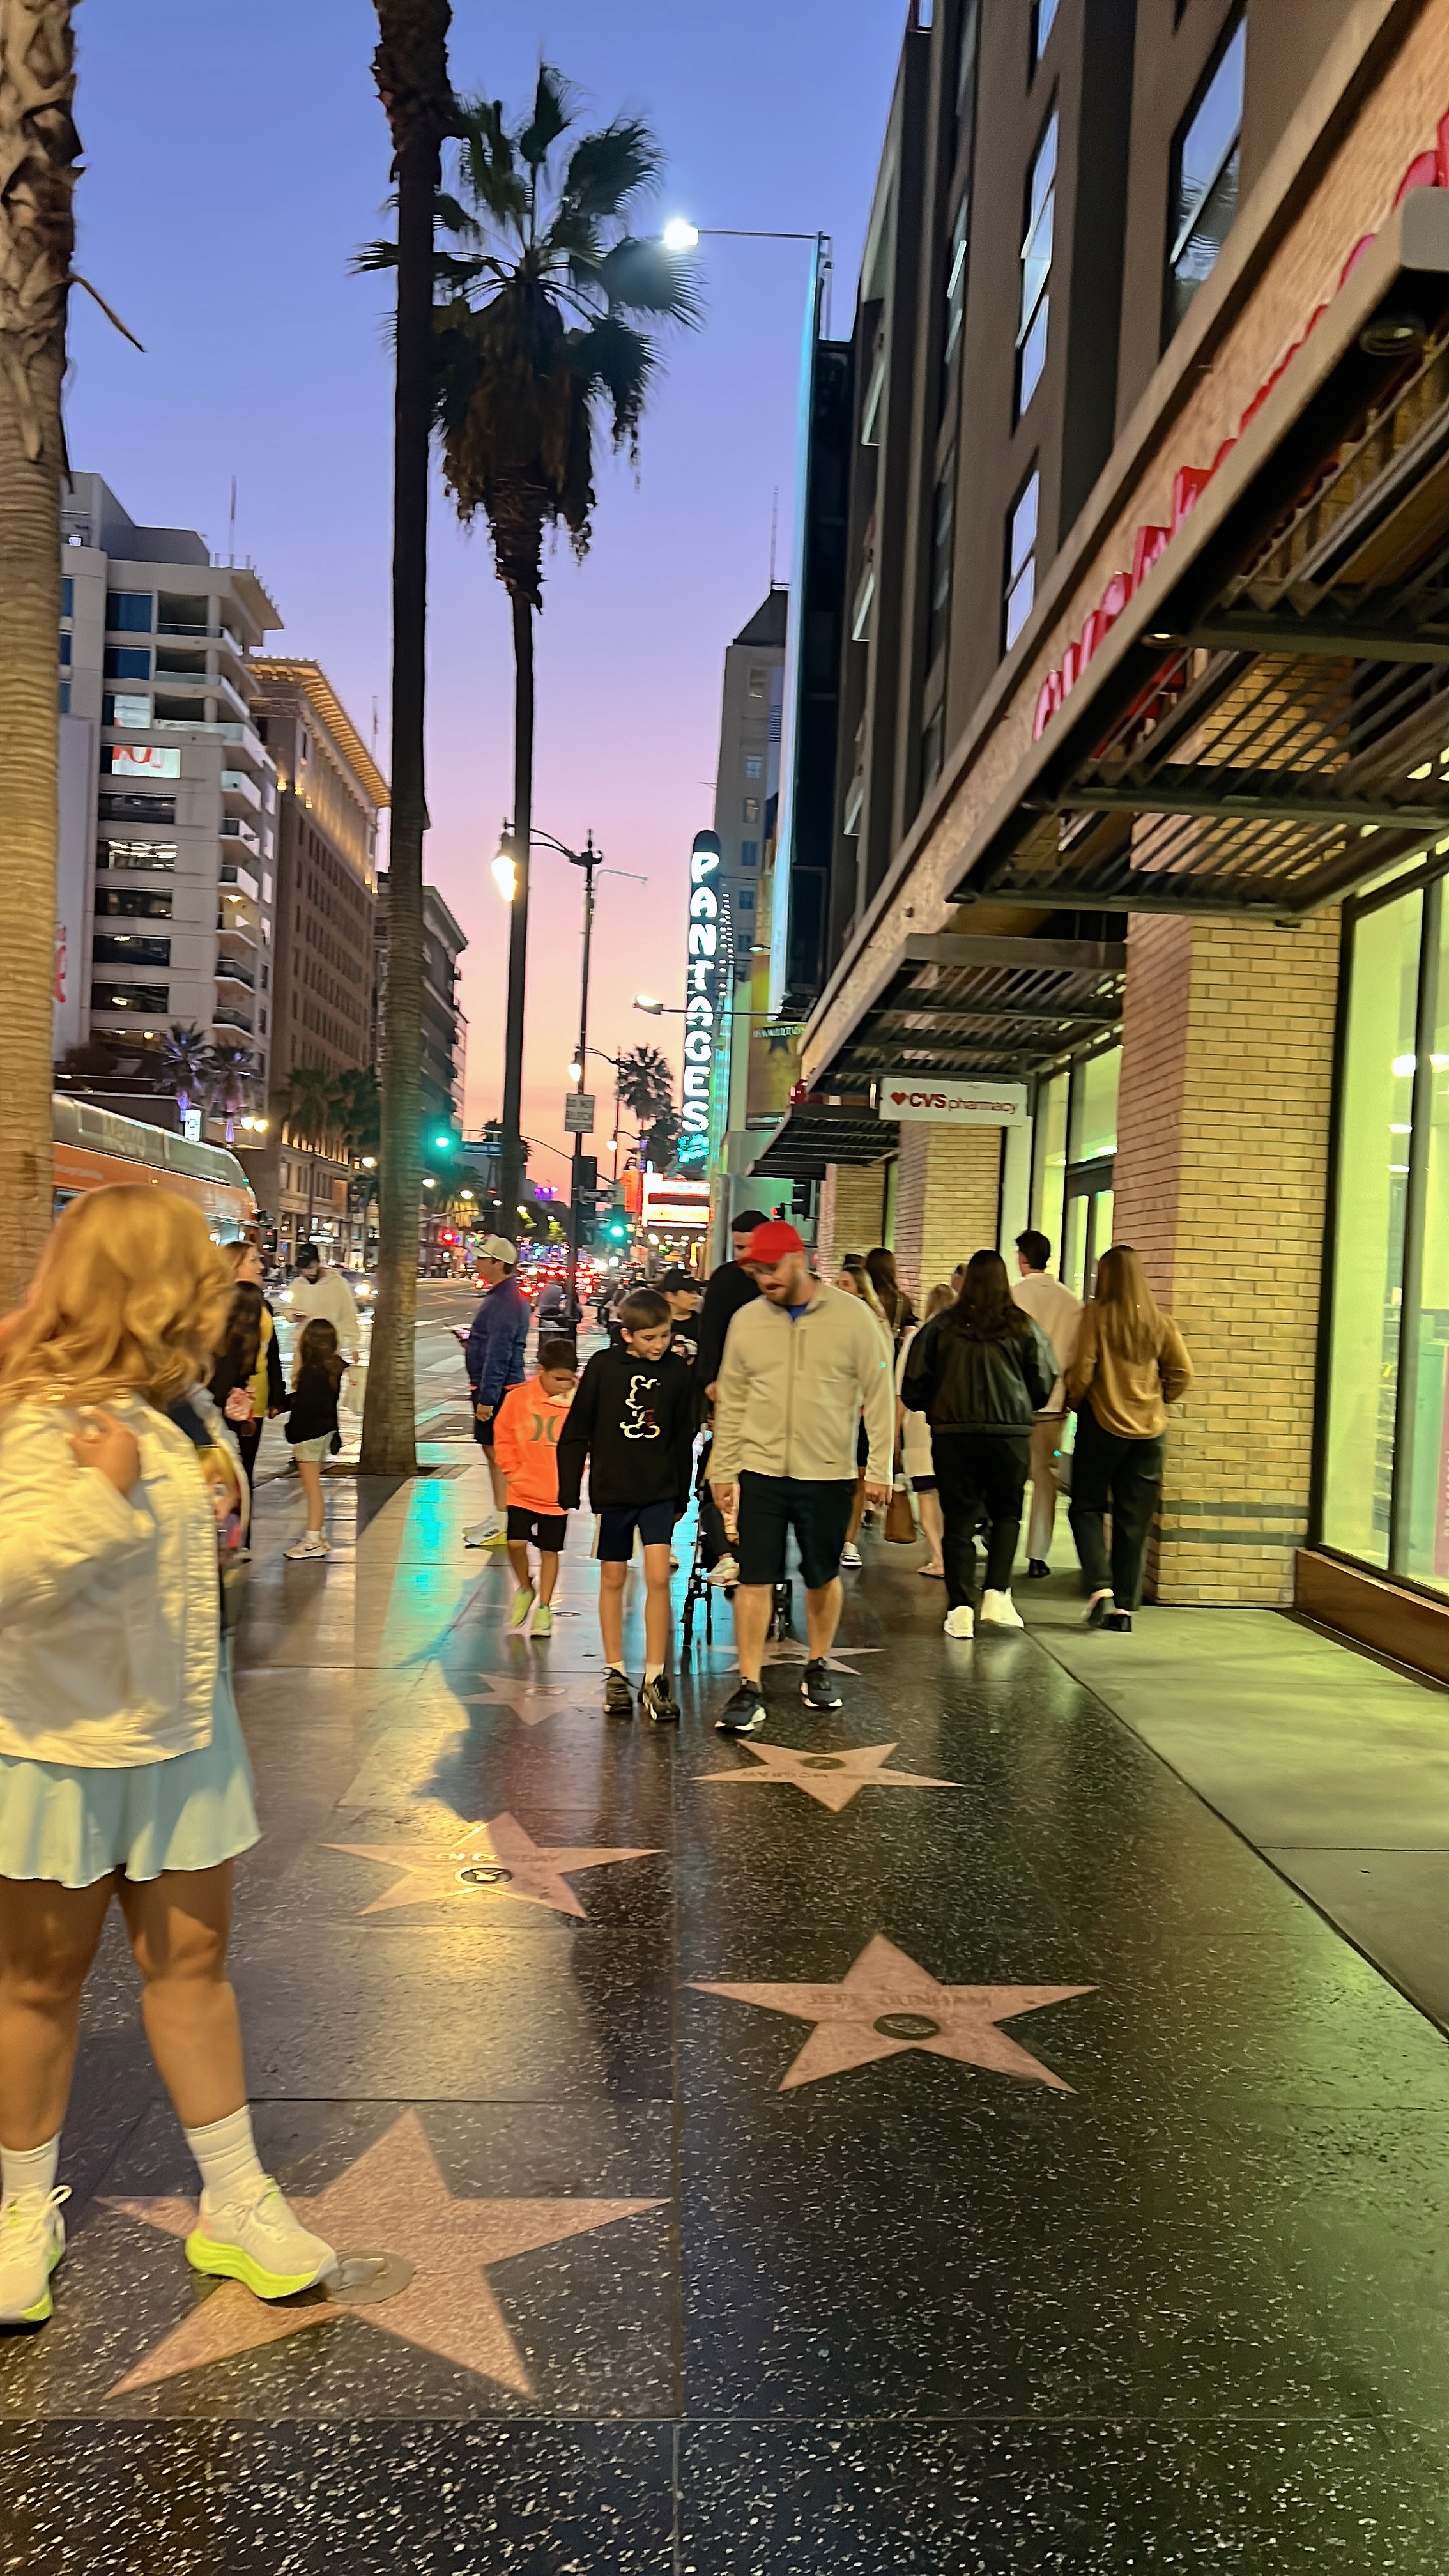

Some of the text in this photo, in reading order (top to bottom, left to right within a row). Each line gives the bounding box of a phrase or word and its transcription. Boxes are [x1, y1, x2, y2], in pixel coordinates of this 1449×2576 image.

[682, 852, 719, 1131] PANTAGES
[910, 1092, 1018, 1114] CVS pharmacy
